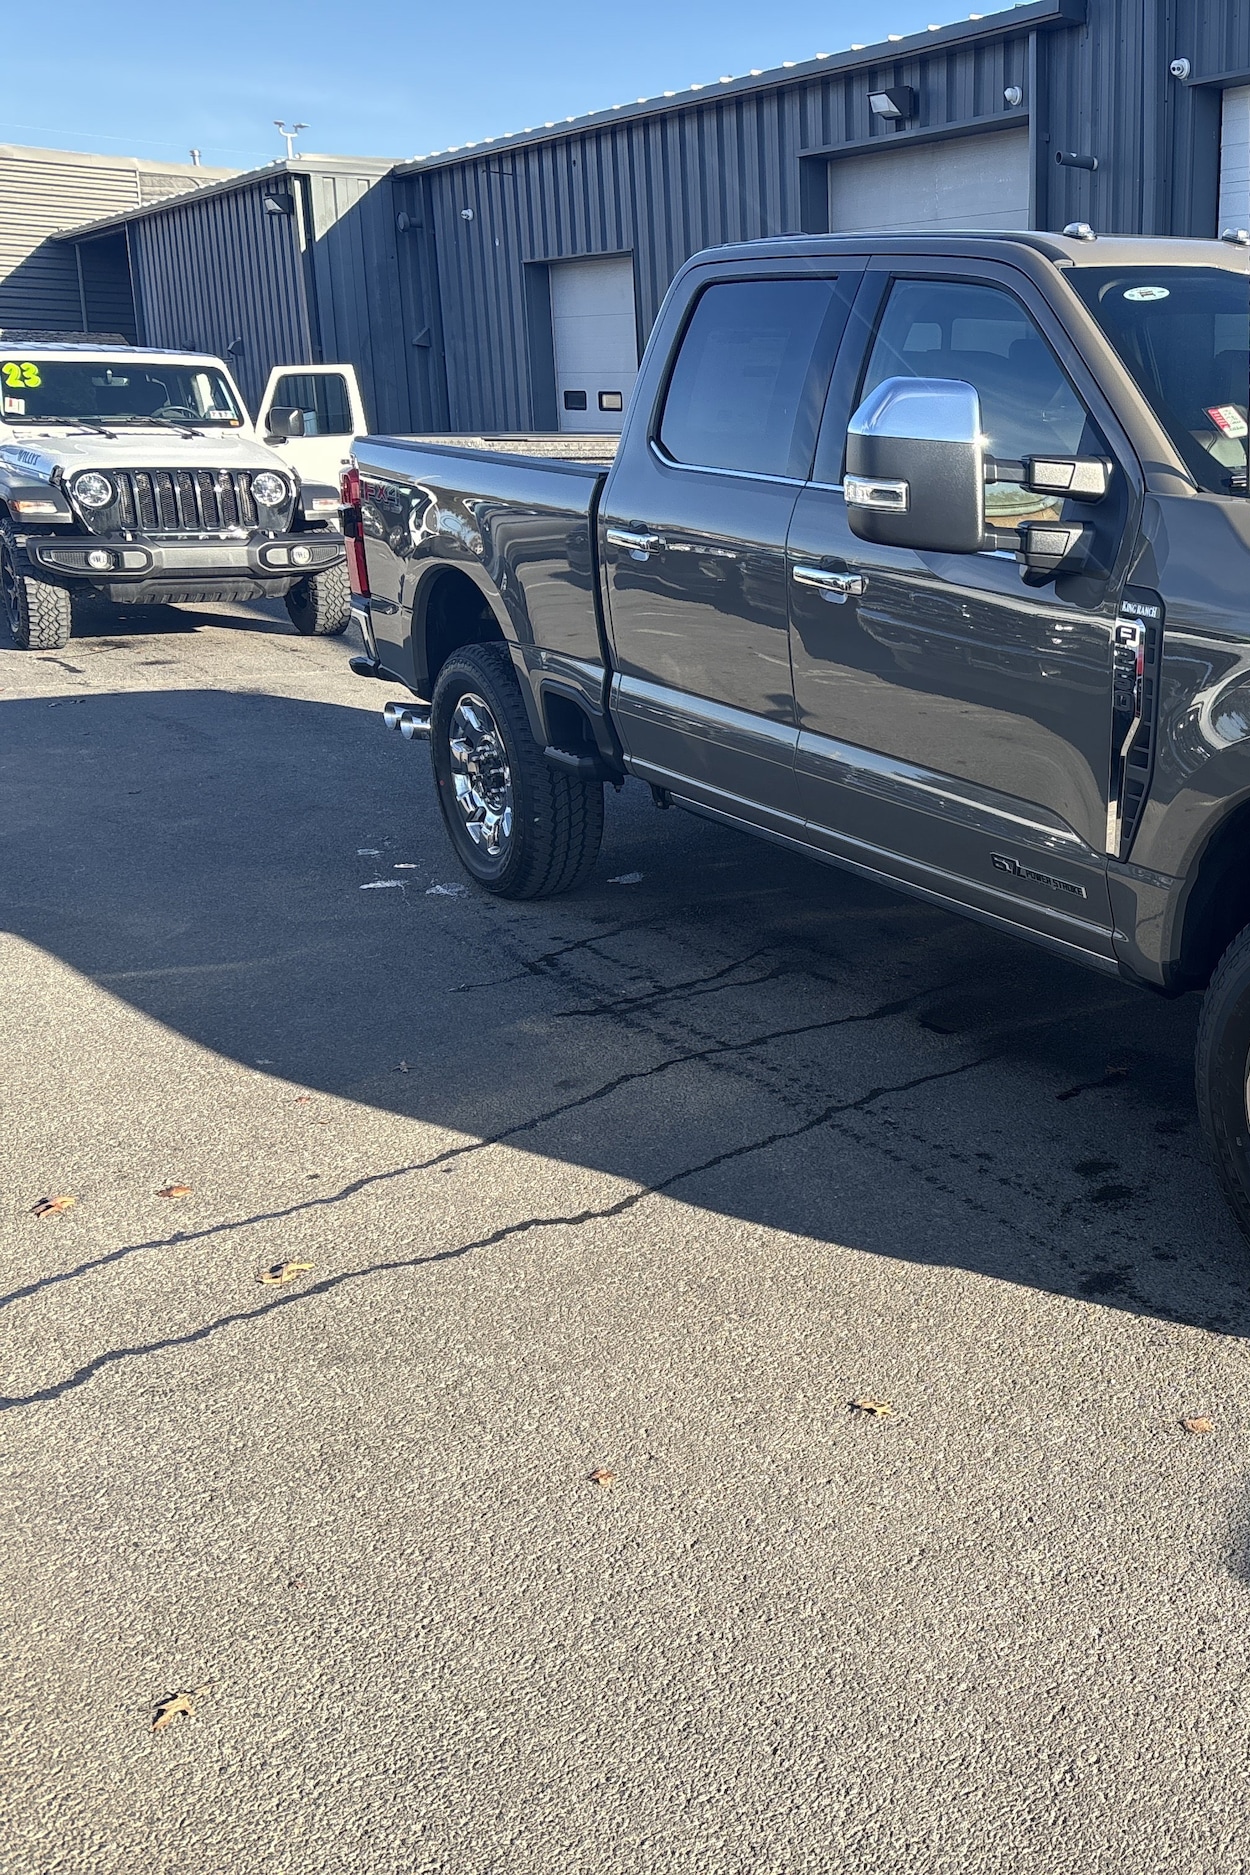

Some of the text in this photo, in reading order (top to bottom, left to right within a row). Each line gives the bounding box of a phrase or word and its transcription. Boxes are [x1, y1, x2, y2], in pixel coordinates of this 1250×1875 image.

[1, 361, 43, 389] 23
[363, 481, 400, 505] FX4
[1121, 600, 1158, 618] KING RANCH
[1026, 870, 1052, 886] POWER
[1052, 879, 1083, 897] STROKE
